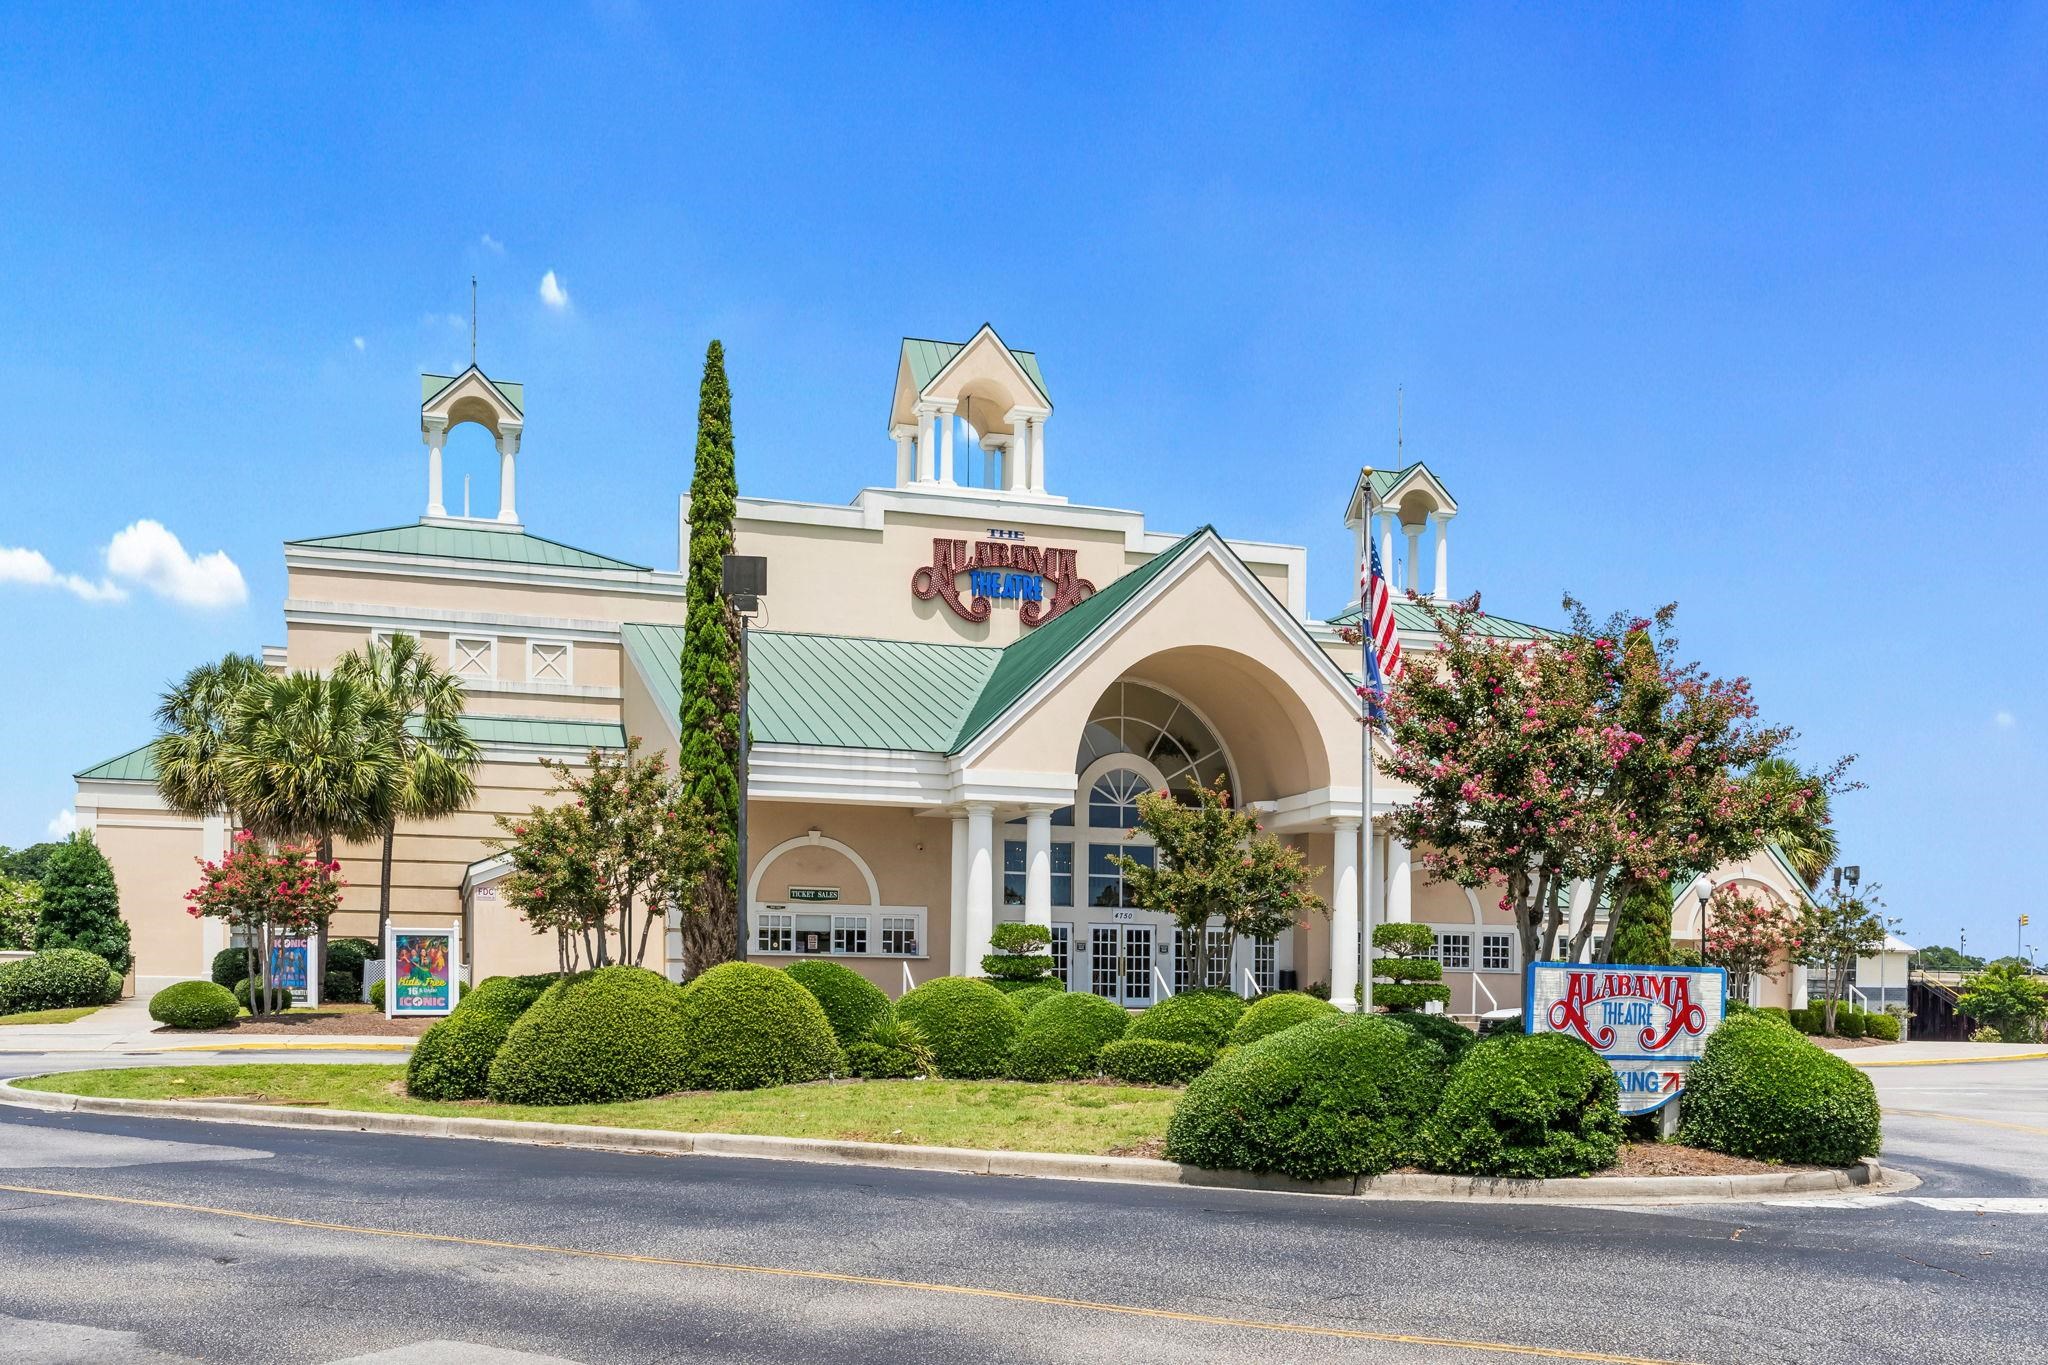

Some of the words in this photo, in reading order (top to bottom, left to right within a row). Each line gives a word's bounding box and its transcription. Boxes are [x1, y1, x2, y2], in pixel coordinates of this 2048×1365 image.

[987, 528, 1025, 539] THE
[911, 538, 1096, 627] ALABAMA
[969, 569, 1043, 601] THEATRE
[478, 887, 494, 896] FDC
[791, 890, 815, 898] TICKET
[817, 890, 838, 898] SALES
[398, 977, 421, 986] Kids
[422, 977, 446, 987] Free
[407, 987, 418, 995] 16
[400, 997, 446, 1006] ICONIC
[1548, 971, 1706, 1051] ALABAMA
[1602, 1001, 1653, 1026] THEATRE
[1613, 1071, 1659, 1093] KING
